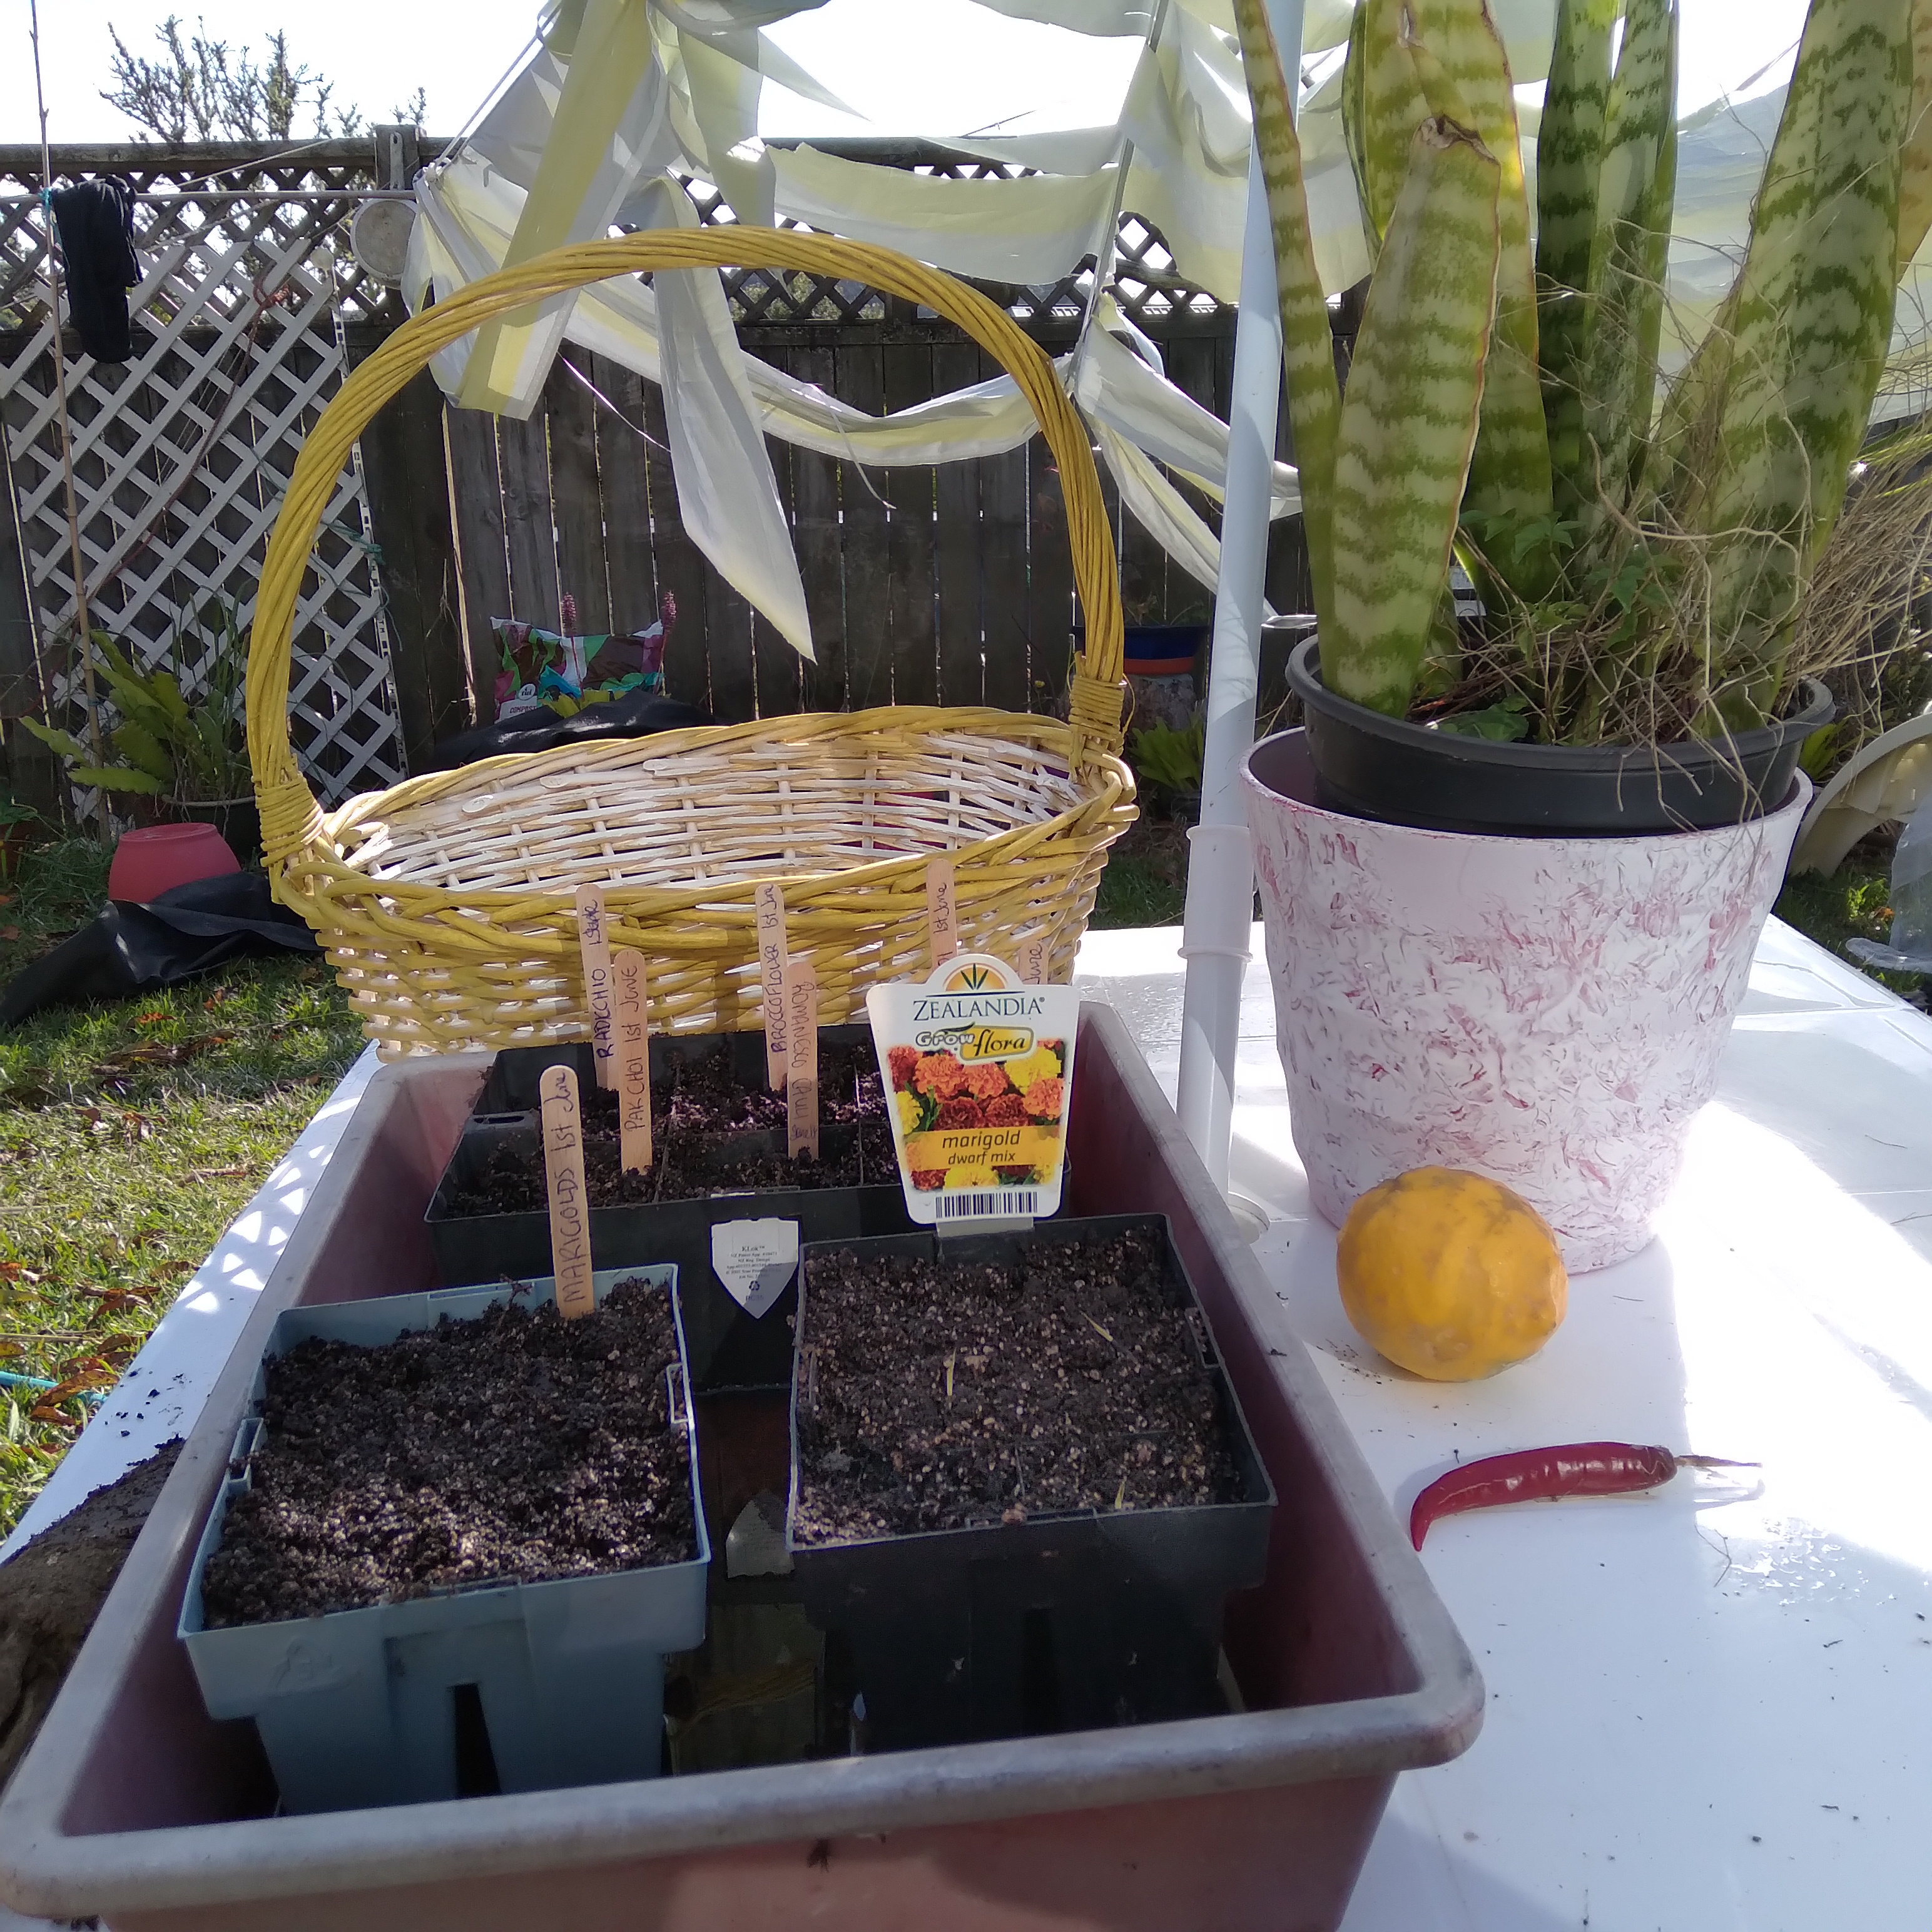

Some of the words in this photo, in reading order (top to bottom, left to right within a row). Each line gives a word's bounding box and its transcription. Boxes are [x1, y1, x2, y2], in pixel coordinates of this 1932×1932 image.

[973, 1029, 1025, 1057] flora
[942, 1130, 1020, 1151] marigold
[948, 1150, 987, 1166] dwarf
[990, 1150, 1016, 1162] mix
